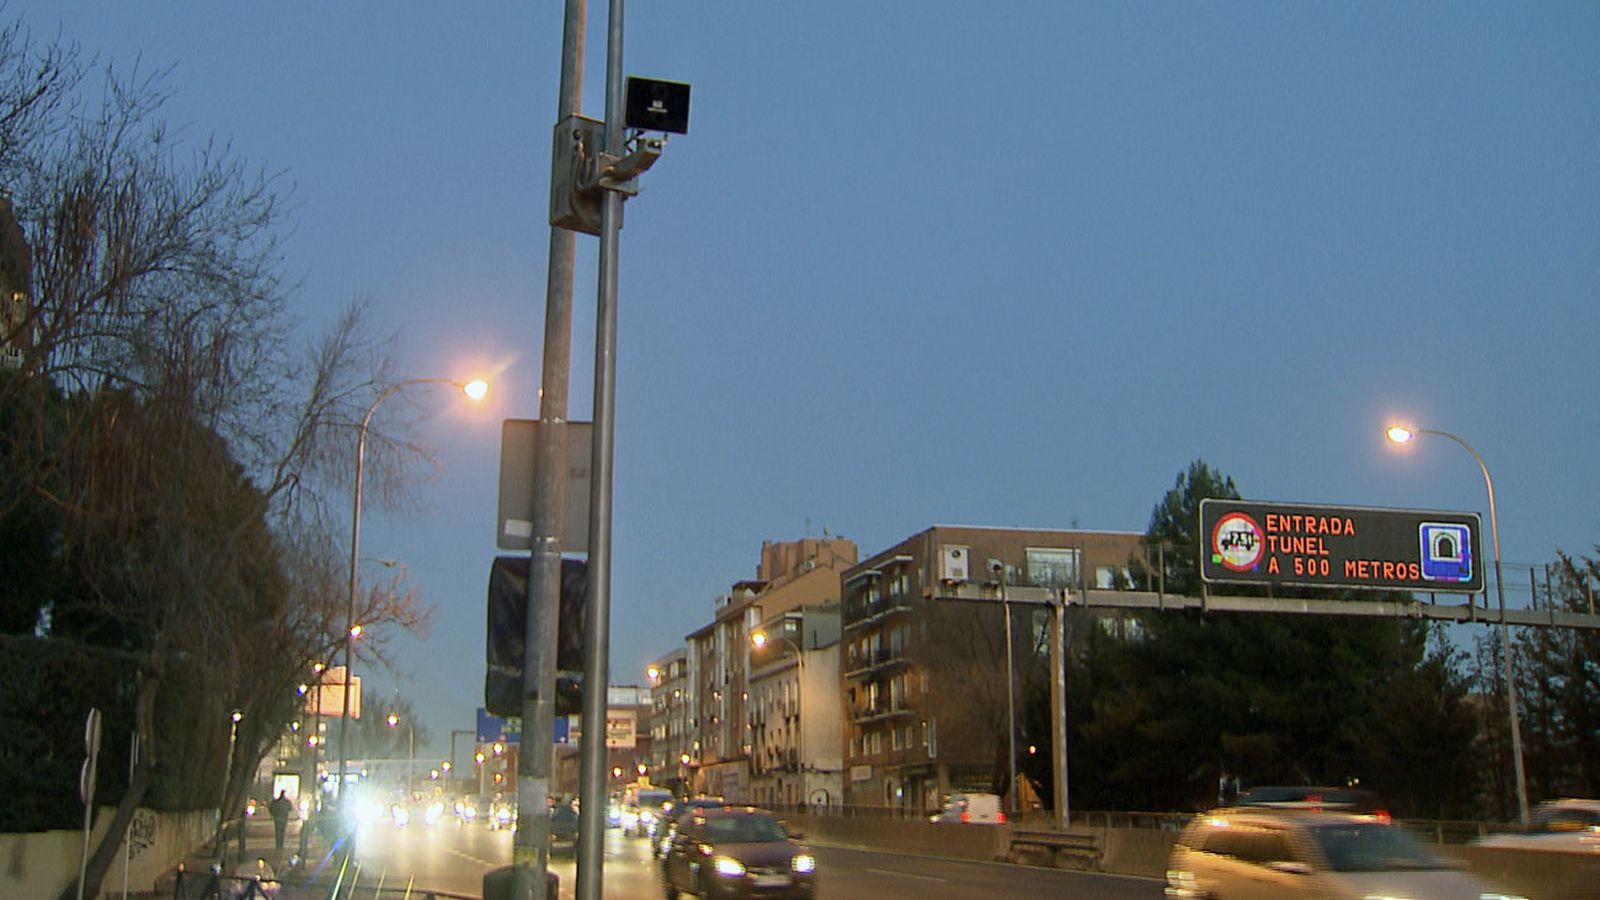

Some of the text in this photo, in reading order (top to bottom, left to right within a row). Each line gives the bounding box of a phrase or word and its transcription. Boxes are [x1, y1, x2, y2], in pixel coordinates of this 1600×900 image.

[1266, 514, 1355, 536] ENTRADA
[1267, 535, 1330, 555] TUNEL
[1268, 557, 1420, 580] A 500 METROS
